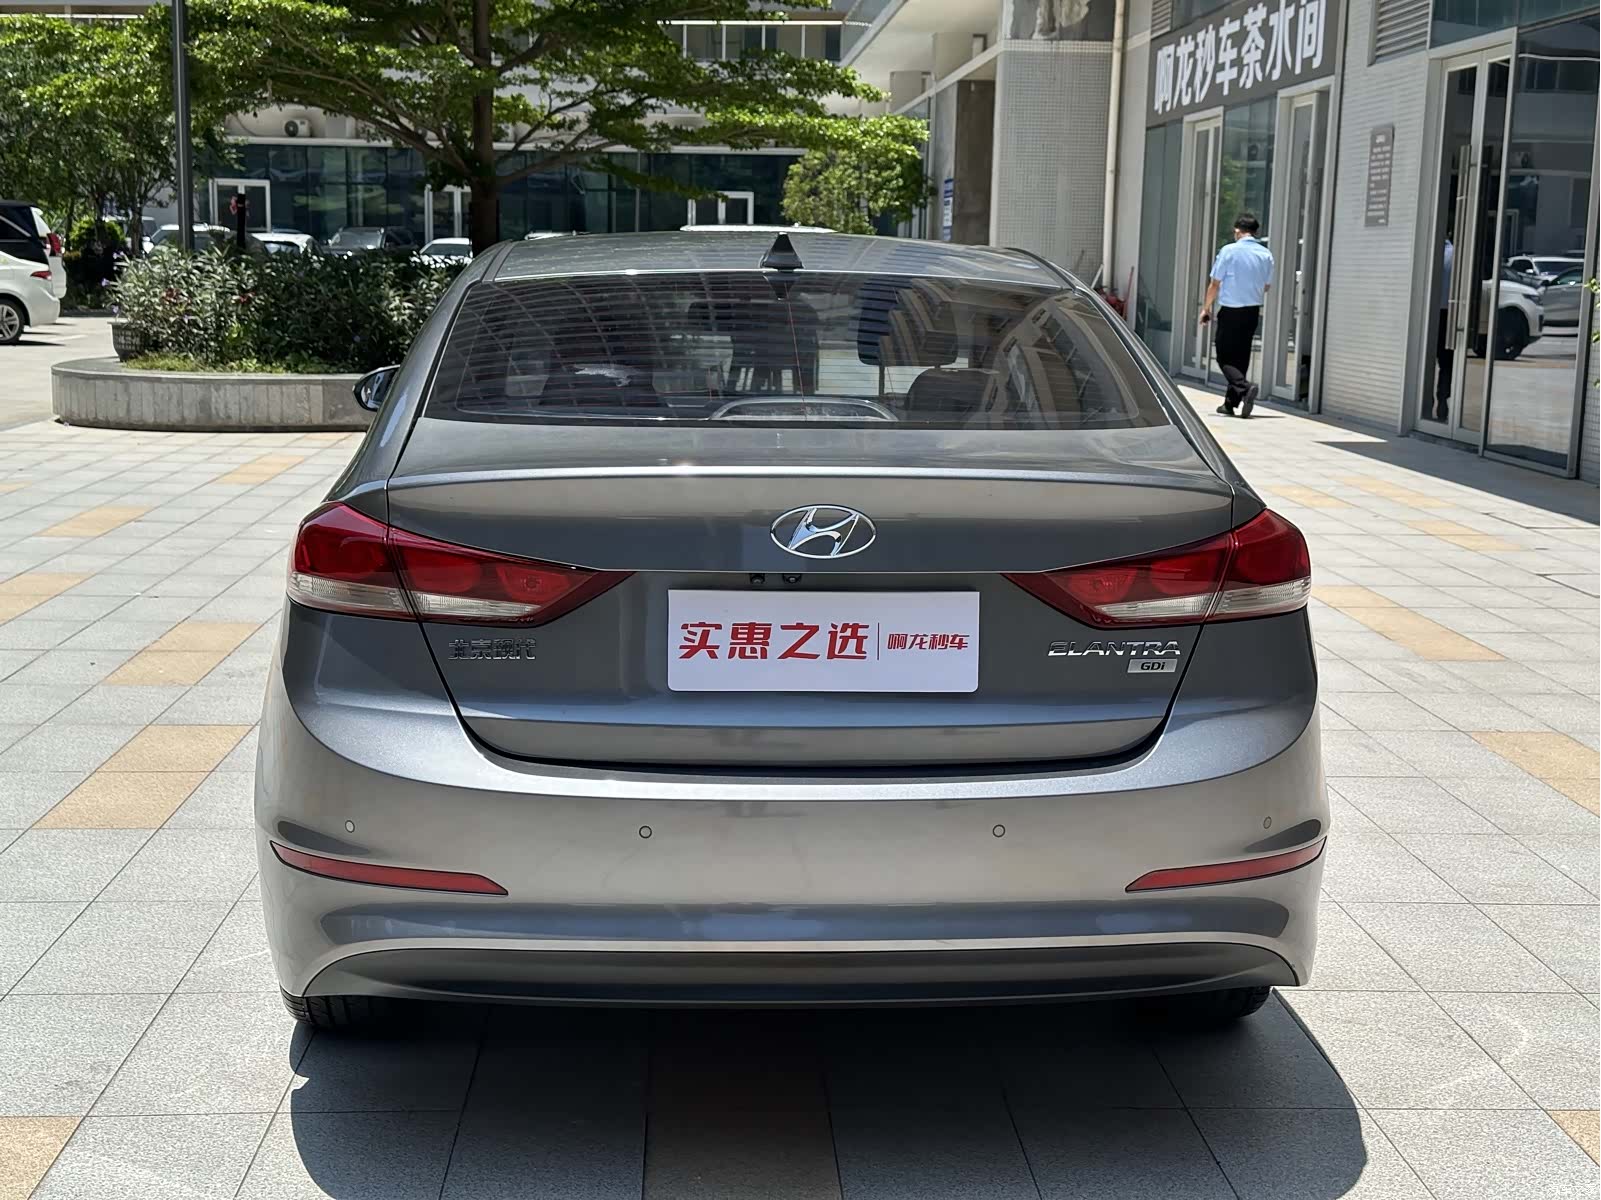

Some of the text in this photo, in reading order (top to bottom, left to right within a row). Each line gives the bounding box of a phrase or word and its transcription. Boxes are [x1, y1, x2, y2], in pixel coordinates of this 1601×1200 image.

[1154, 0, 1327, 115] 啊龙秒车茶水间
[448, 639, 536, 659] 北京现代
[678, 621, 970, 660] 实惠之选 啊龙秒车
[1047, 640, 1181, 657] ELANTRA
[1140, 661, 1165, 671] GDi
